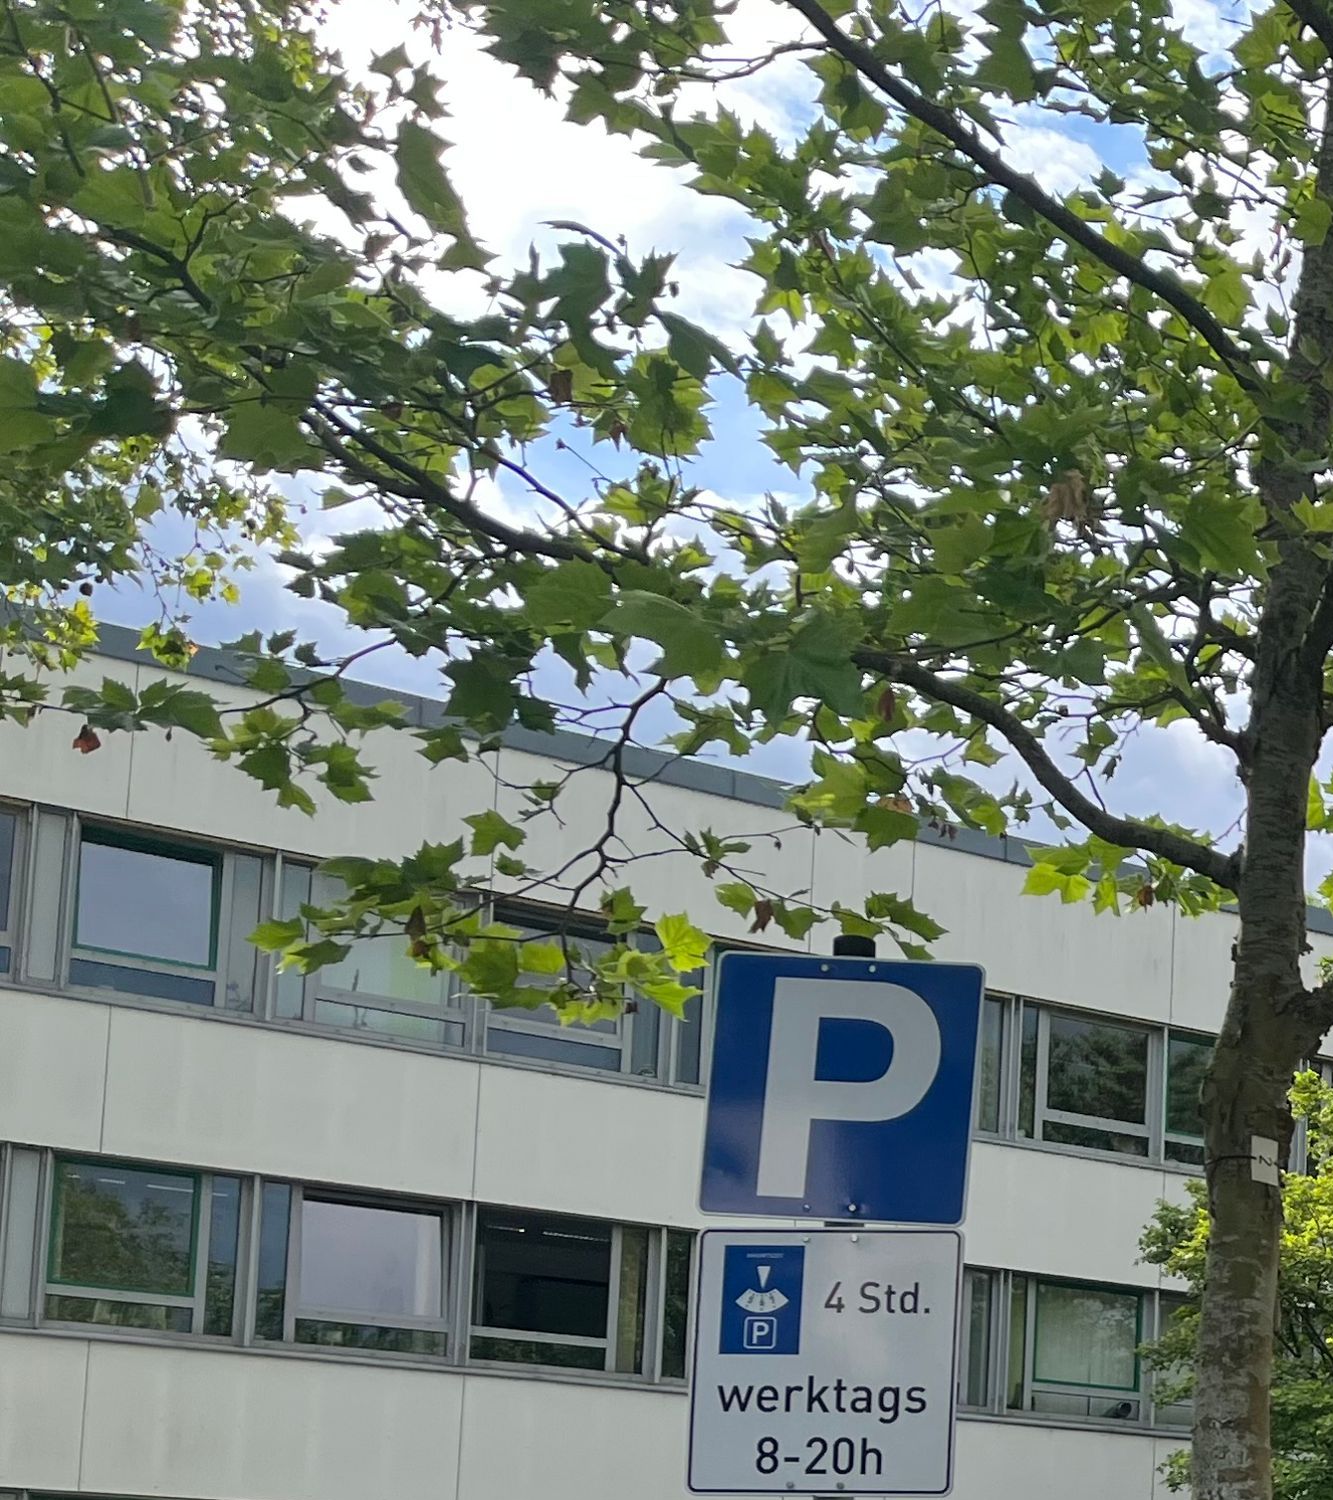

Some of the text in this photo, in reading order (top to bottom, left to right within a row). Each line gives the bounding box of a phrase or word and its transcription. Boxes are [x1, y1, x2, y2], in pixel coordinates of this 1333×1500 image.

[756, 976, 941, 1198] P
[824, 1281, 930, 1314] 4 Std.
[751, 1321, 770, 1344] P
[717, 1375, 927, 1424] werktags
[755, 1436, 882, 1475] 8-20h
